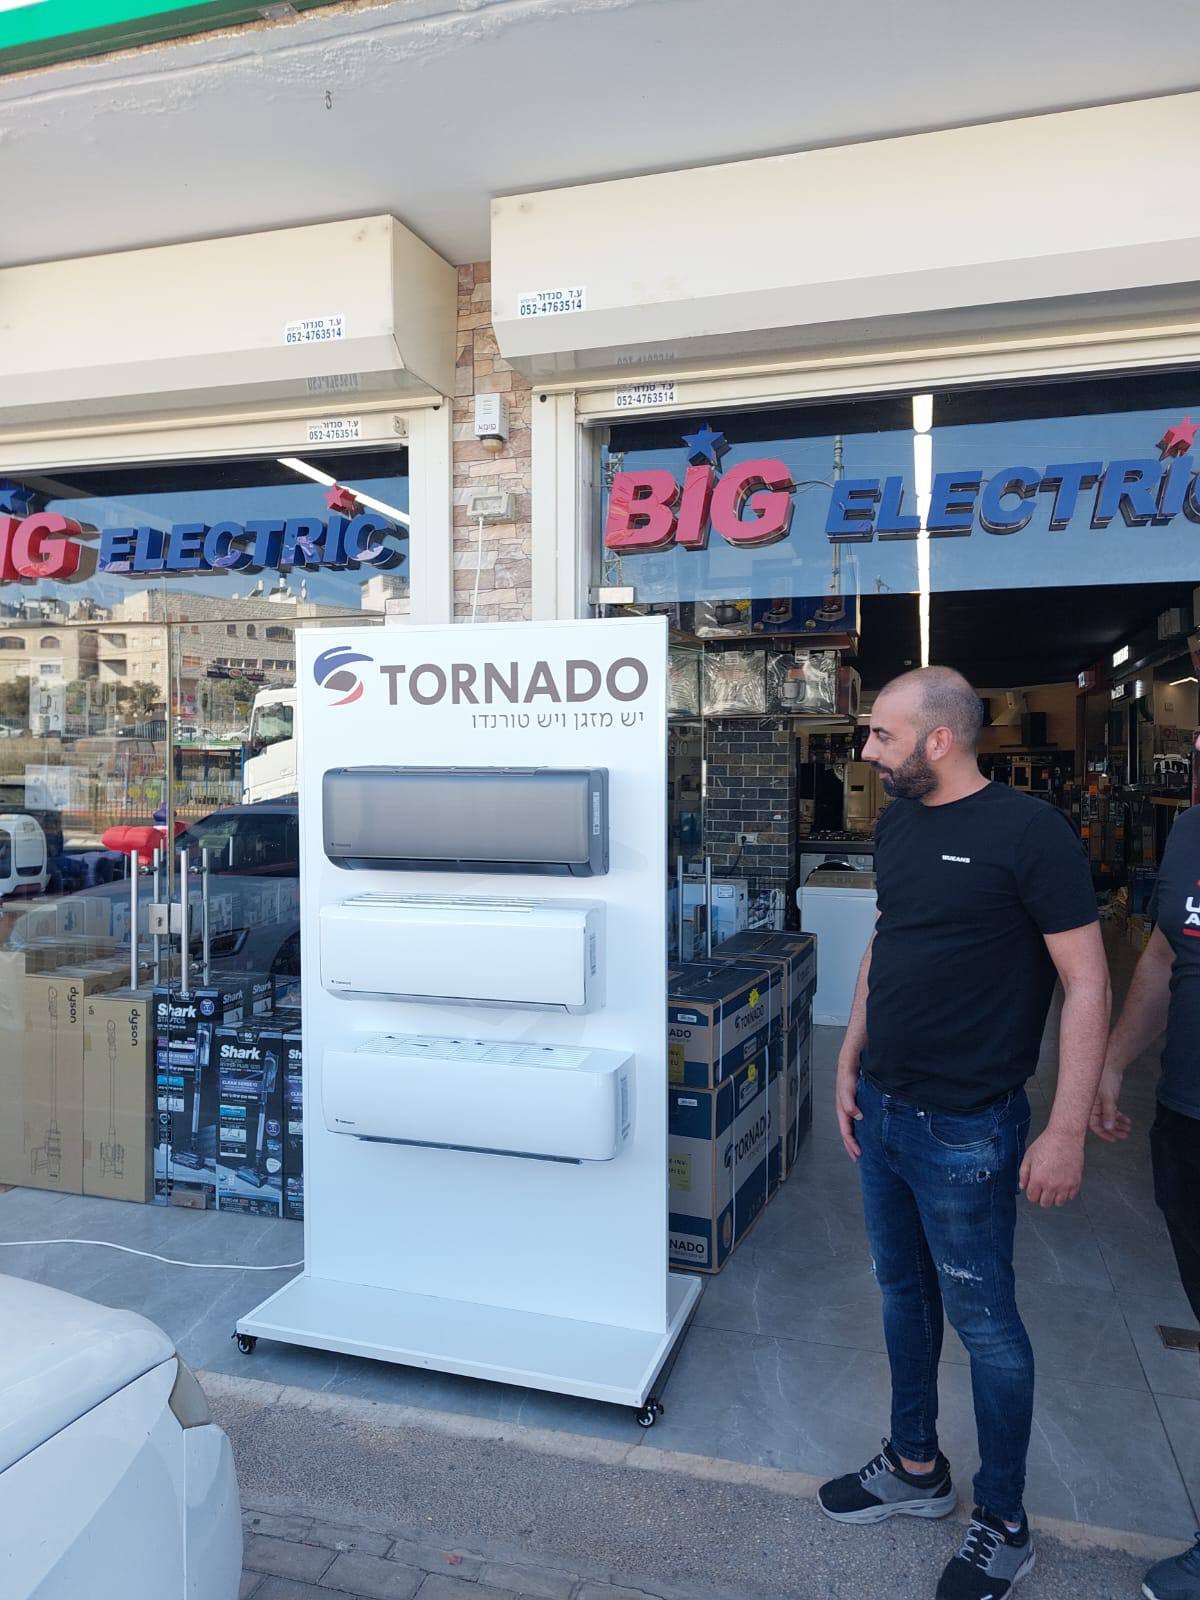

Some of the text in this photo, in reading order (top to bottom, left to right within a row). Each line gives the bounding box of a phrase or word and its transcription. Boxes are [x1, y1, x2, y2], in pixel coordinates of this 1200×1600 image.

[520, 299, 582, 315] 052-4763514
[286, 328, 341, 343] 052-4763514
[617, 391, 674, 406] 052-4763514
[309, 429, 359, 440] 052-4763514
[604, 459, 795, 552] BIG
[100, 514, 402, 575] ELECTRIC
[380, 657, 649, 706] TORNADO
[472, 711, 644, 730] יש מזגן ויש טורנדו
[67, 986, 79, 1024] dyson
[223, 990, 243, 1004] Shark
[157, 1003, 197, 1018] Shark
[740, 1004, 765, 1030] TORNADO
[129, 1008, 141, 1047] dyson
[220, 1044, 261, 1060] Shark
